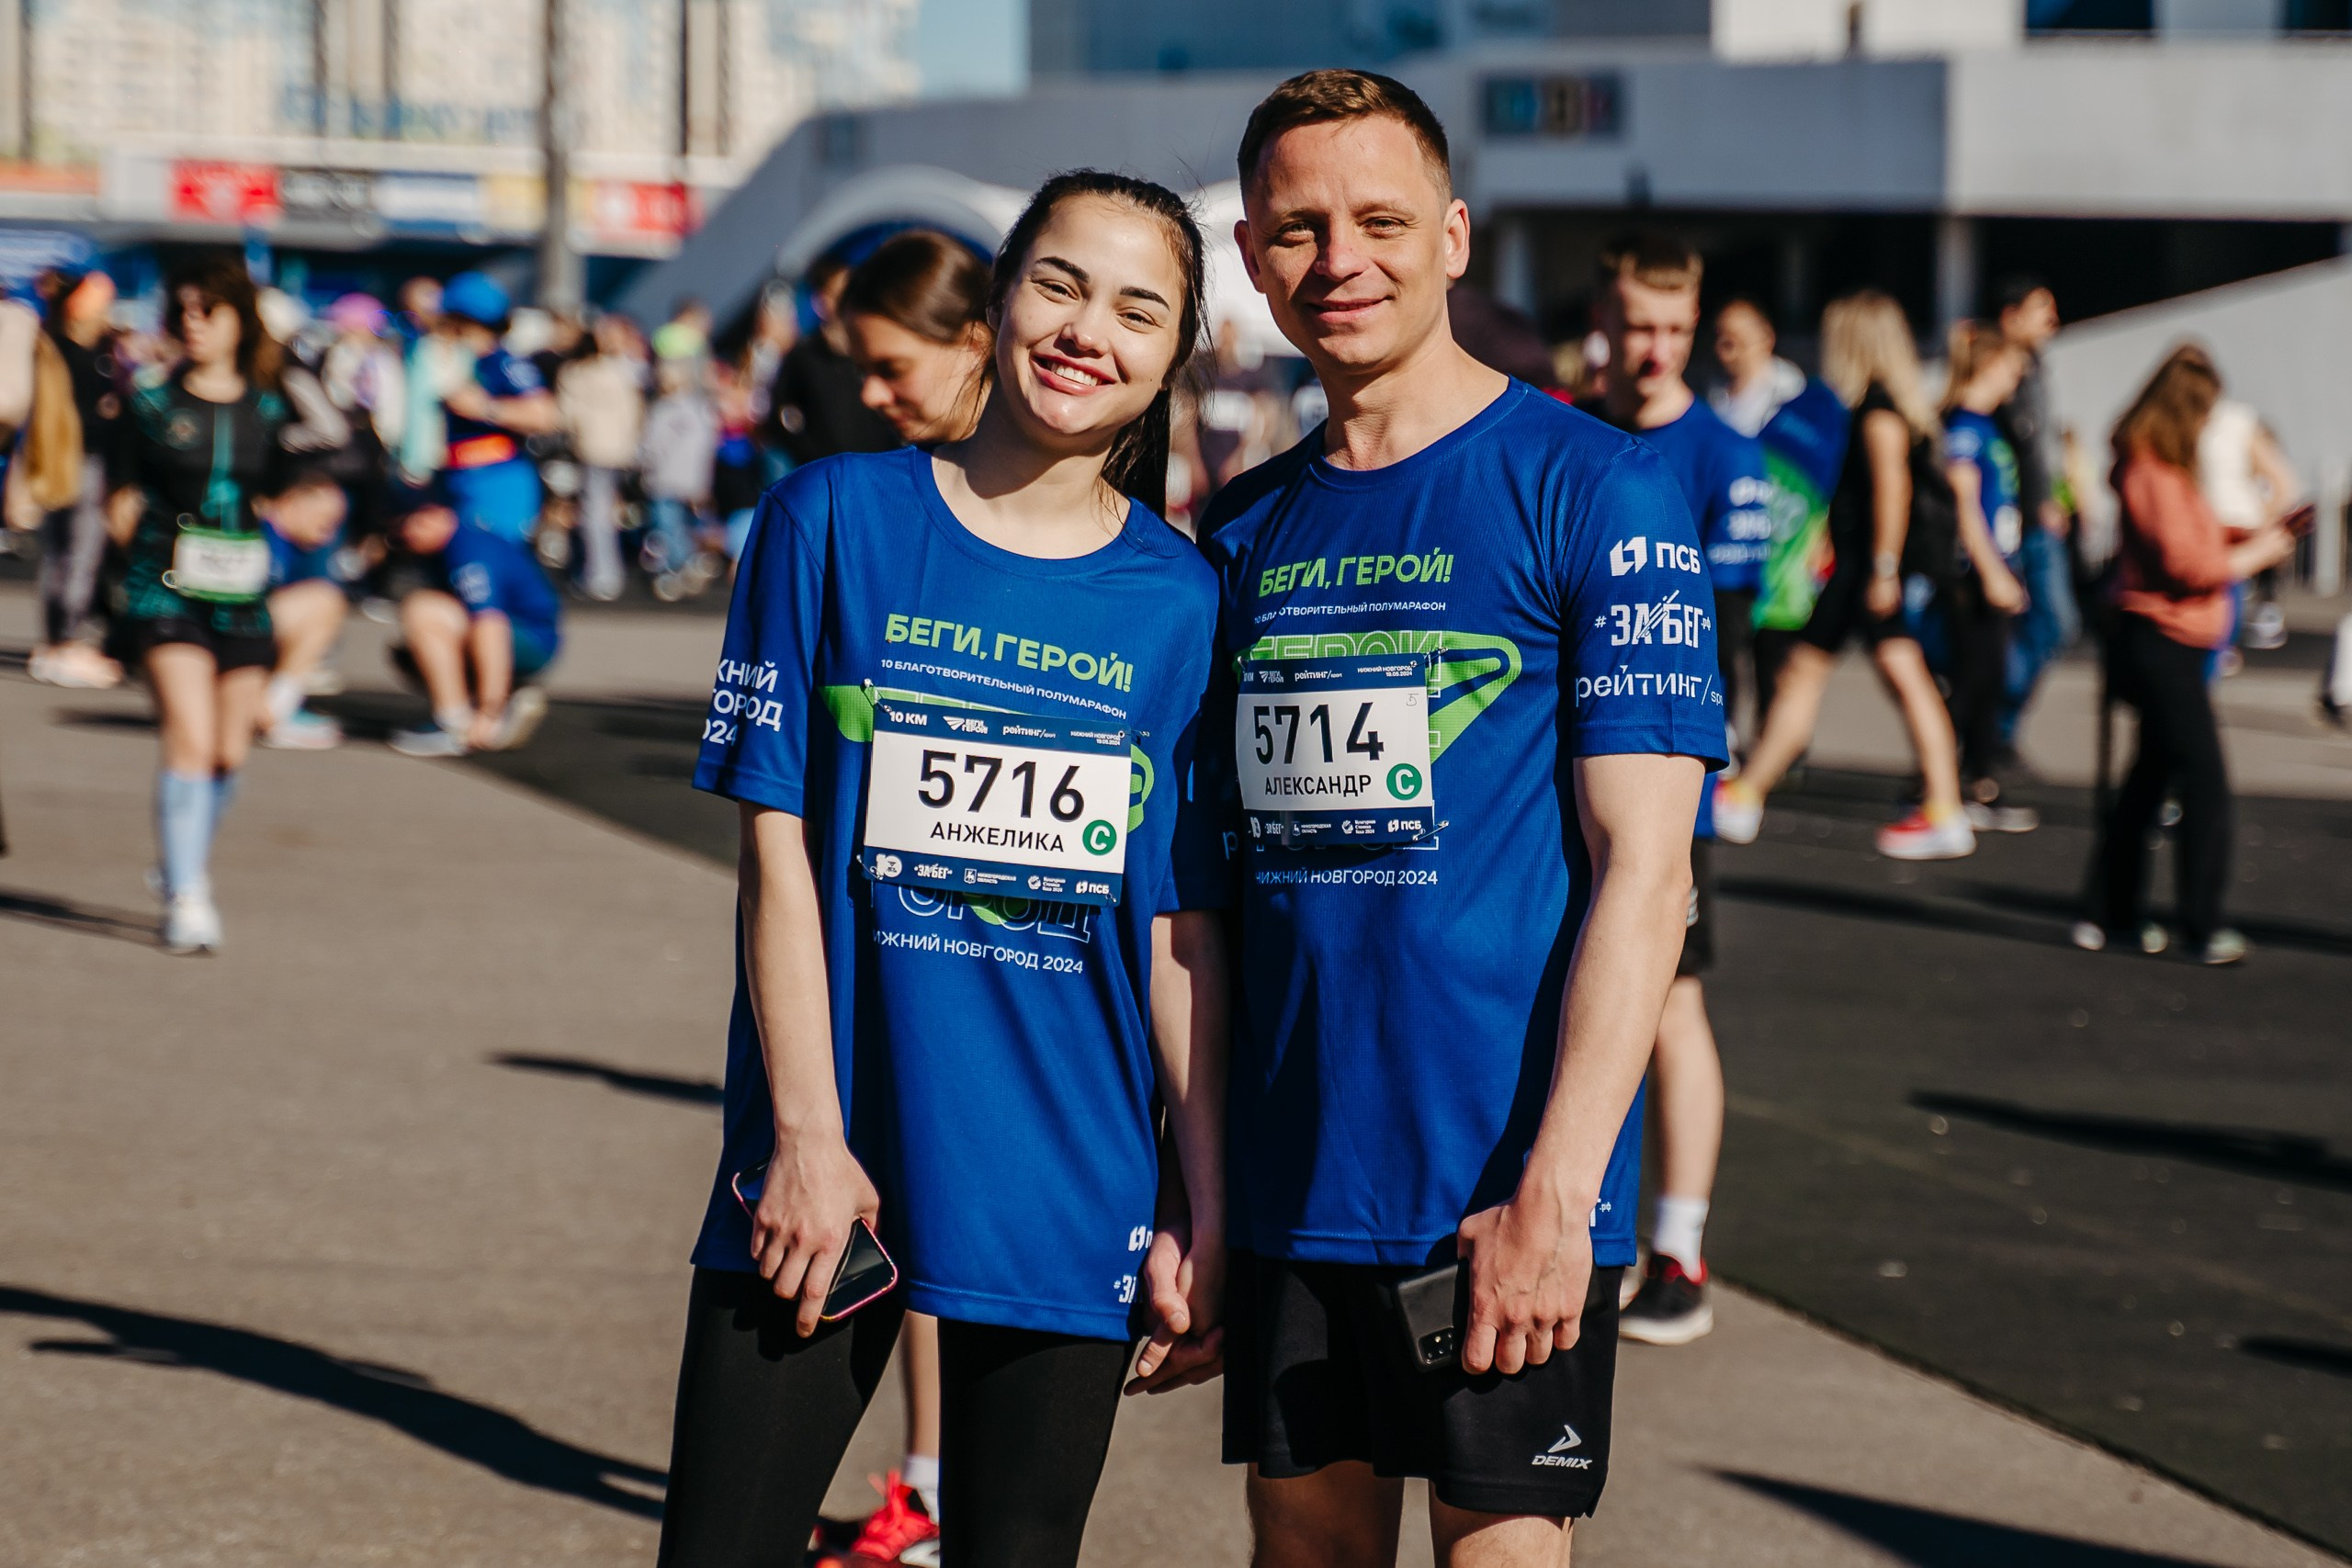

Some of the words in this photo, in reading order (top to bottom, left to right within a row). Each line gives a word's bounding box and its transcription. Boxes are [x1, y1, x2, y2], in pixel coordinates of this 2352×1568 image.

[1259, 557, 1331, 597] БЕГИ,
[1336, 547, 1454, 586] ГЕРОЙ!
[1655, 542, 1701, 574] ПСБ
[1369, 601, 1446, 613] ПОЛУМАРАФОН
[885, 613, 988, 660] БЕГИ,
[993, 632, 1135, 694] ГЕРОЙ!
[880, 659, 894, 669] 10
[894, 660, 1035, 696] БЛАГОТВОРИТЕЛЬНЫЙ
[1035, 688, 1127, 720] ПОЛУМАРАФОН
[712, 687, 784, 732] ОРОД
[889, 711, 904, 723] 10
[1253, 701, 1385, 765] 5714
[918, 749, 1085, 823] 5716
[1264, 774, 1372, 797] АЛЕКСАНДР
[930, 821, 1065, 853] АНЖЕЛИКА
[1400, 819, 1422, 831] ПСБ
[1088, 883, 1110, 895] ПСБ
[1310, 870, 1396, 886] НОВГОРОД
[1396, 870, 1439, 886] 2024
[943, 939, 1039, 971] НОВГОРОД
[1042, 955, 1084, 975] 2024
[1531, 1455, 1593, 1470] DEMIX
